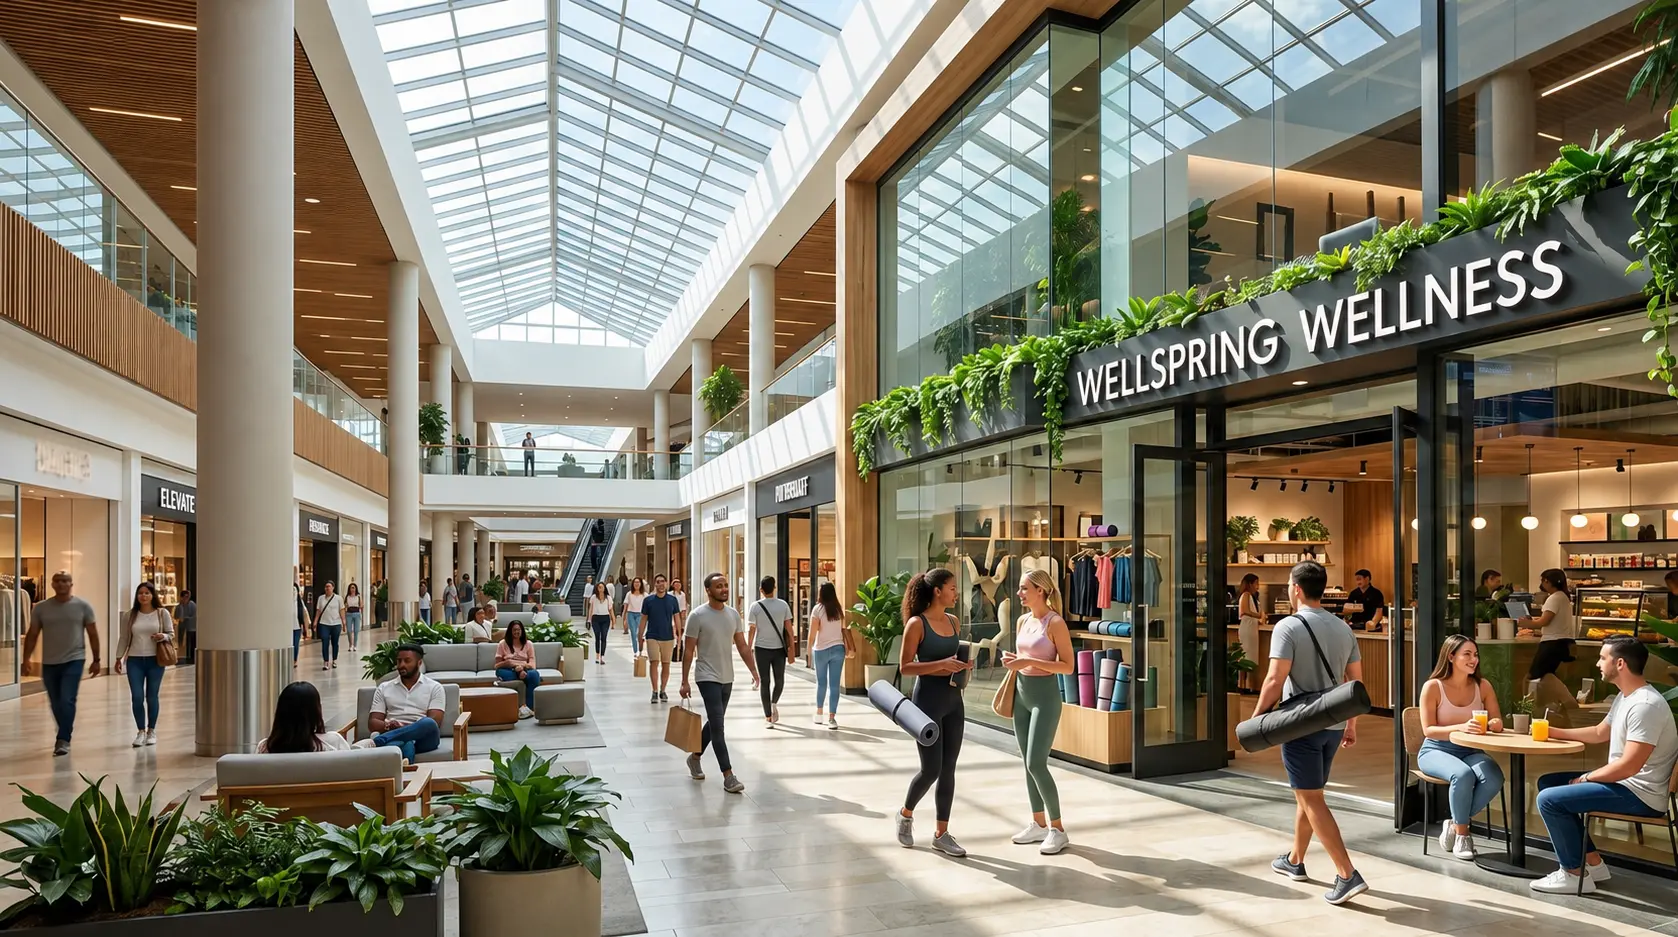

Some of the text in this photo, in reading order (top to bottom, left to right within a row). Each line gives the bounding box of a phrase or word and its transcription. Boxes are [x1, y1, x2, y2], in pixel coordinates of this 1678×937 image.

[1077, 240, 1564, 407] WELLSPRING WELLNESS
[160, 487, 195, 514] ELEVATE
